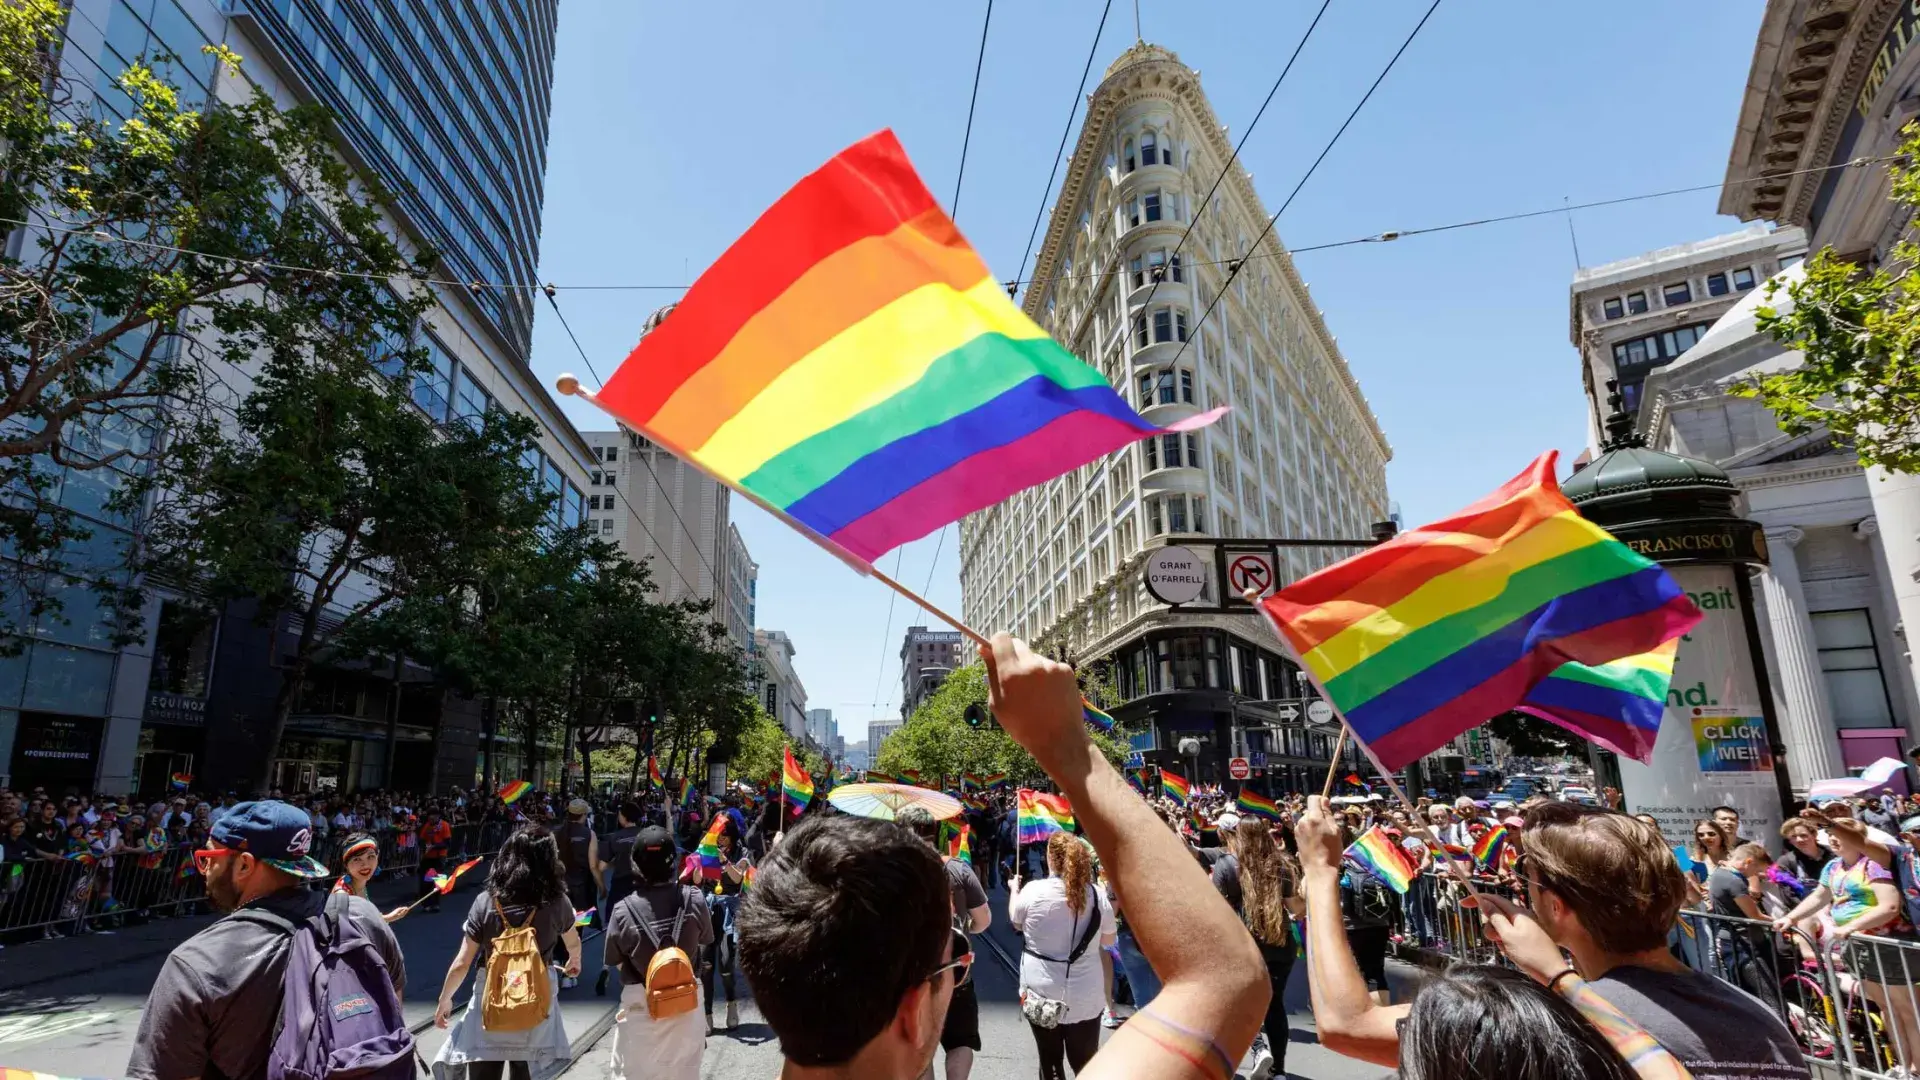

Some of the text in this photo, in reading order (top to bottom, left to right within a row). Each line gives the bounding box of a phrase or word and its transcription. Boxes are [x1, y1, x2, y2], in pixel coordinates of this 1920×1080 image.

[1627, 534, 1734, 553] FRANCISCO
[1159, 561, 1192, 570] GRANT
[1151, 574, 1203, 584] O'FARRELL
[151, 695, 206, 712] EQUINOX
[1703, 725, 1762, 740] CLICK
[1717, 746, 1760, 761] ME!!
[1636, 805, 1684, 814] Facebook
